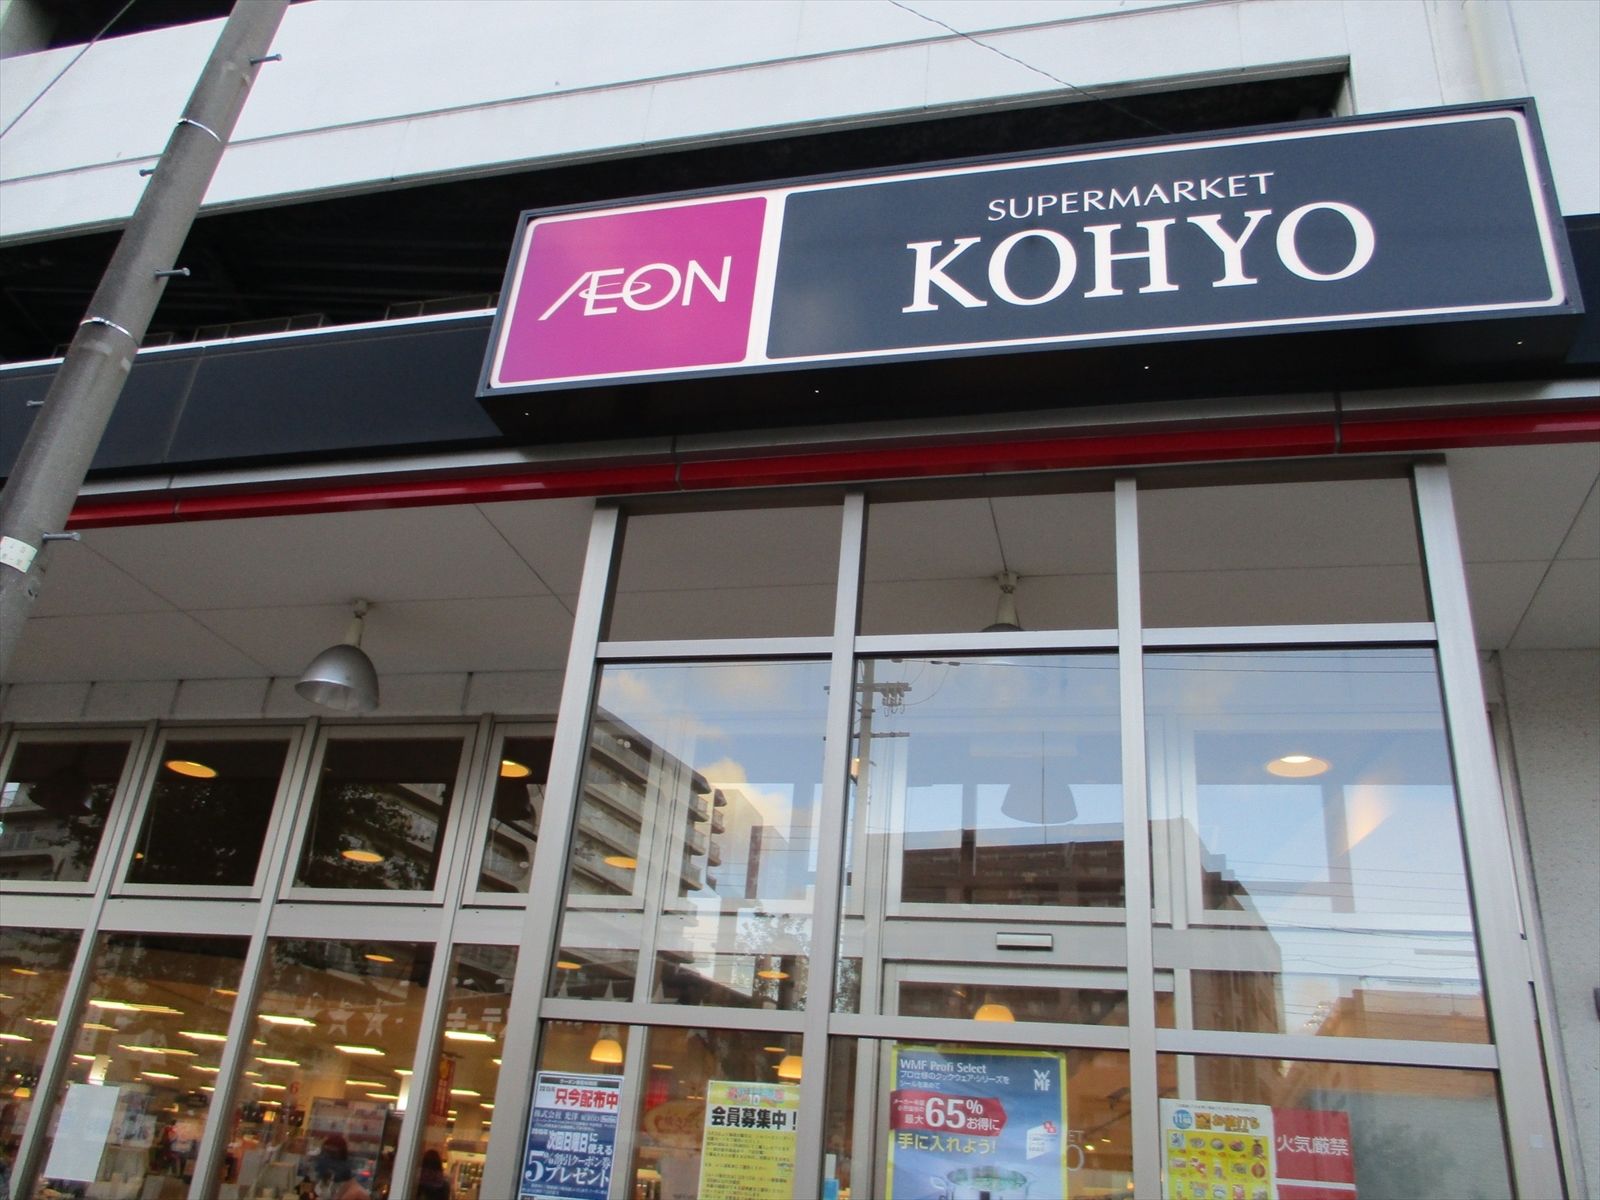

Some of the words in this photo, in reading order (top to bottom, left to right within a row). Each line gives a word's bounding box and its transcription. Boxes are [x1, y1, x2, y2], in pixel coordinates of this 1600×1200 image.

[987, 172, 1274, 222] SUPERMARKET
[902, 201, 1376, 314] KOHYO
[900, 1059, 927, 1070] WMF
[930, 1061, 953, 1072] Profi
[957, 1062, 987, 1074] Select
[555, 1087, 619, 1110] 只今配布中
[904, 1114, 924, 1125] 最大
[967, 1117, 1000, 1131] お得に
[1276, 1135, 1349, 1157] 火気厳禁
[545, 1165, 610, 1188] プレゼント
